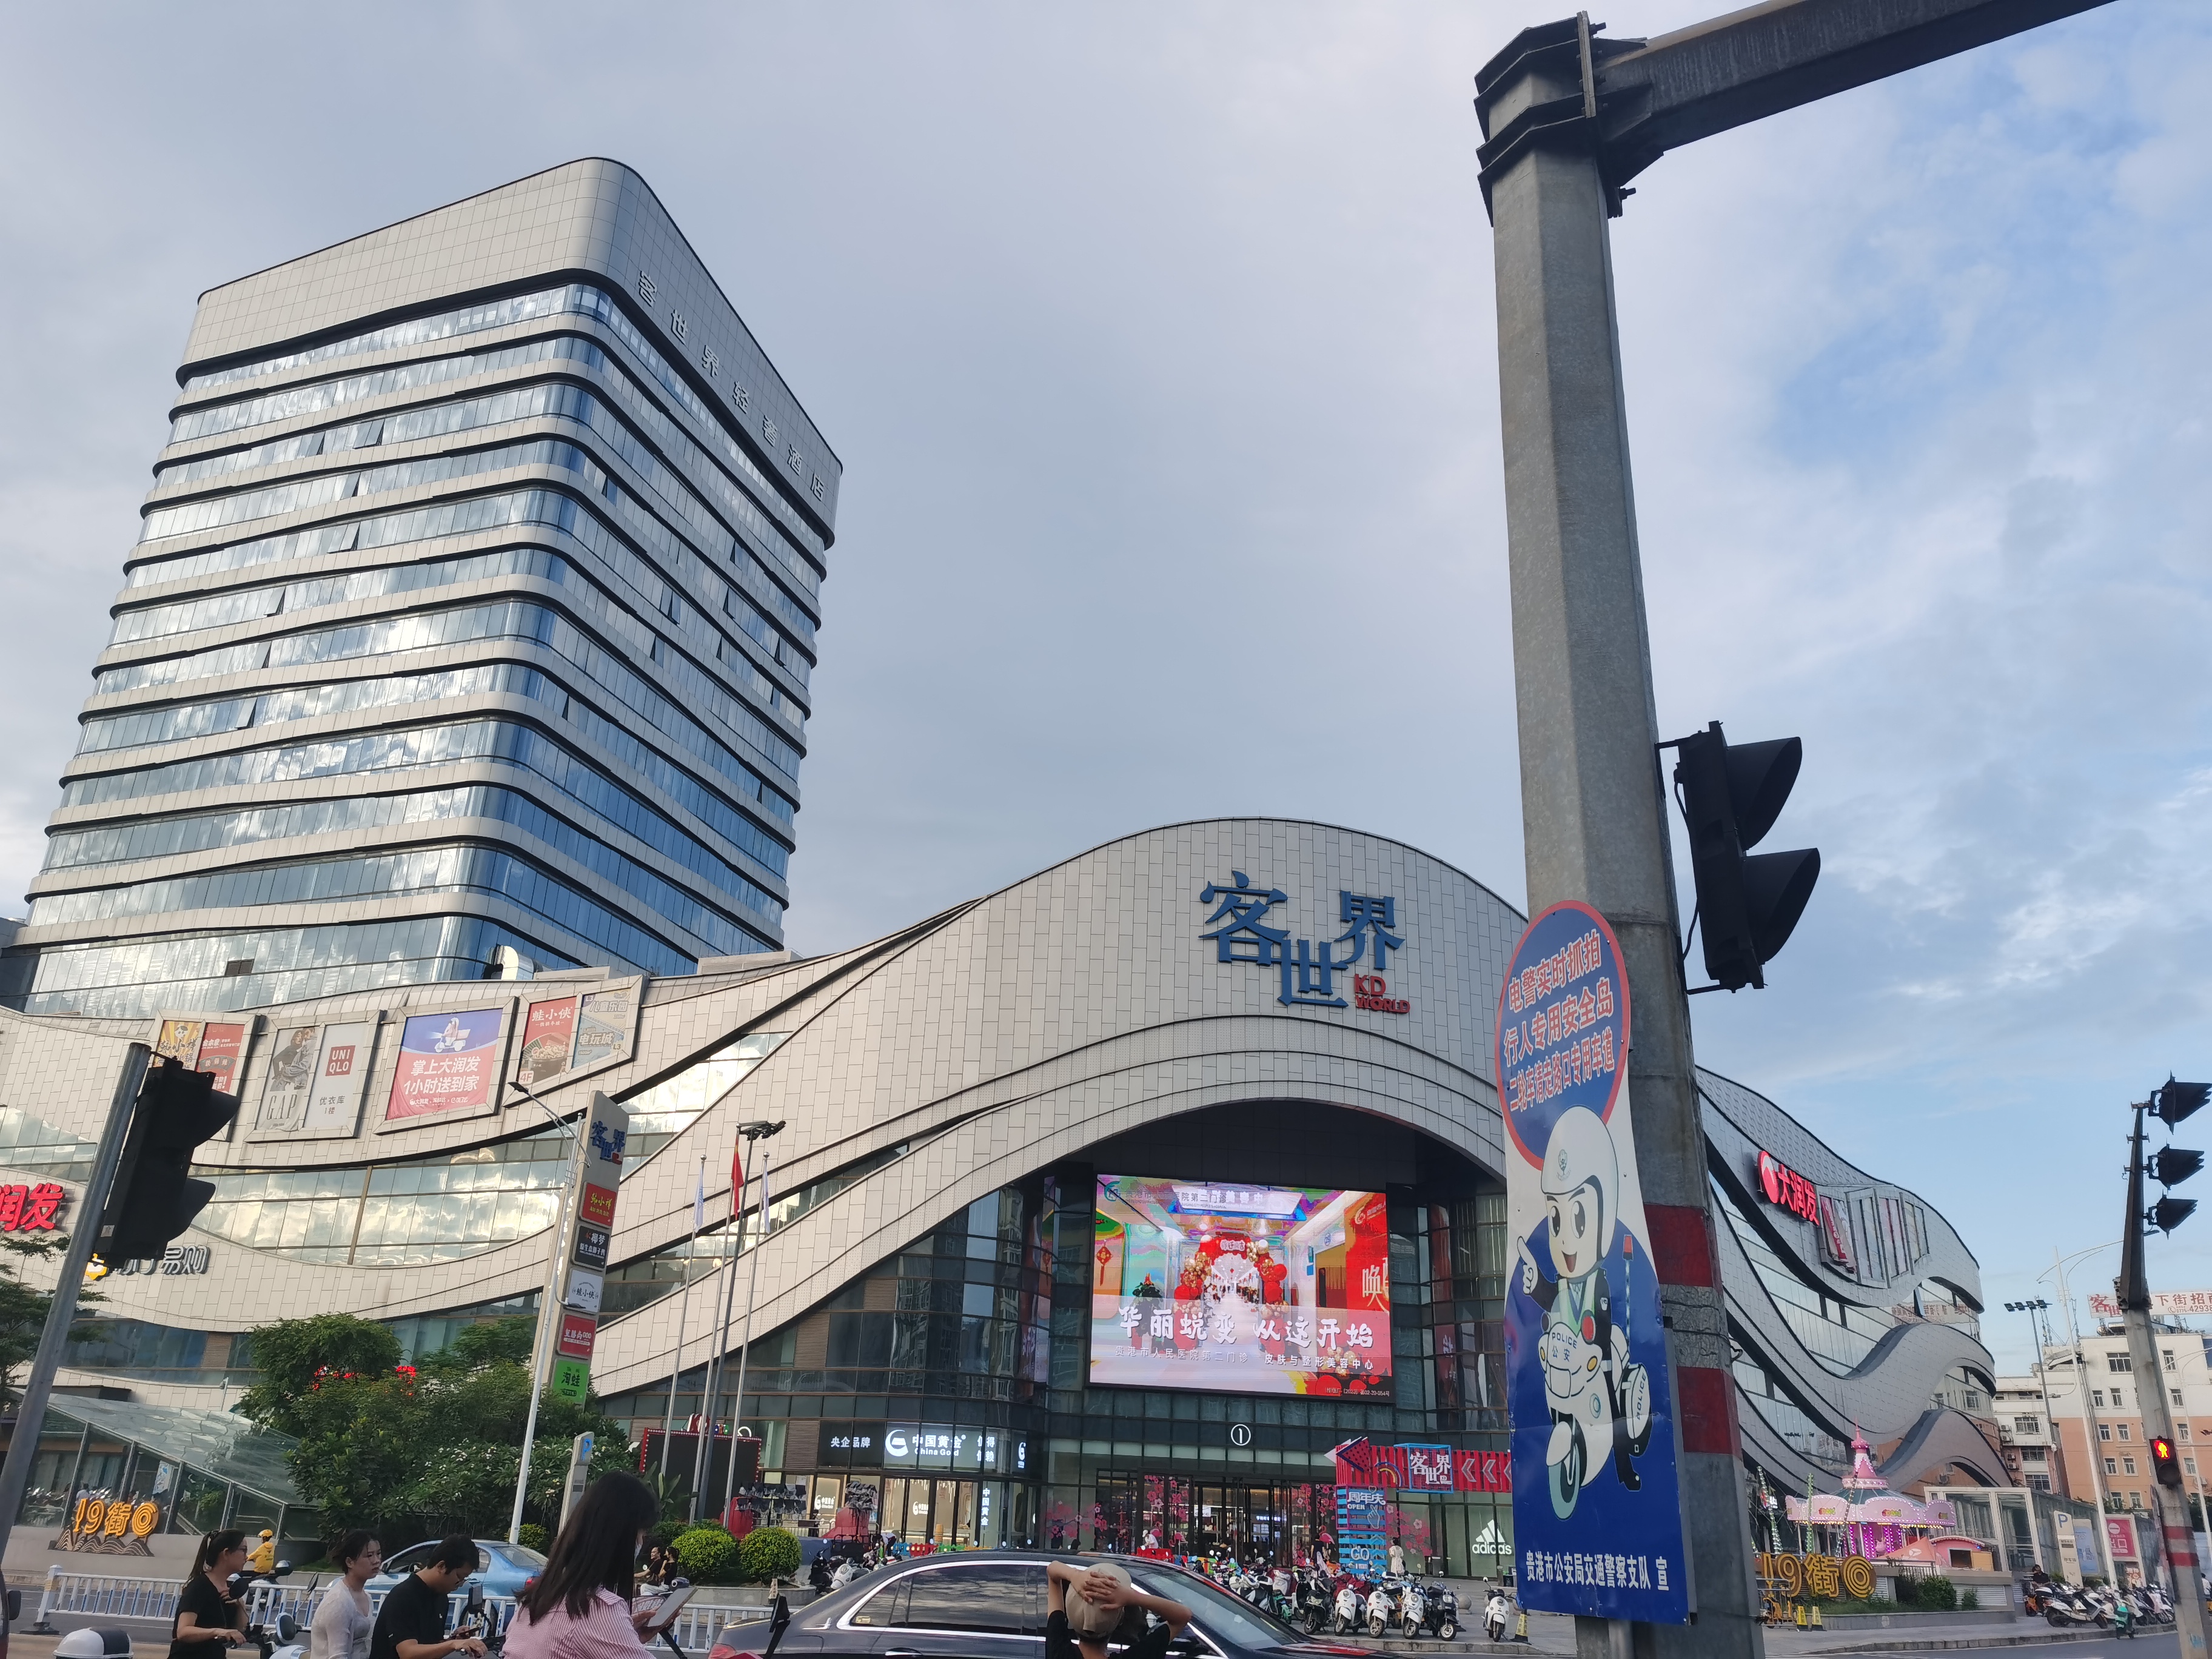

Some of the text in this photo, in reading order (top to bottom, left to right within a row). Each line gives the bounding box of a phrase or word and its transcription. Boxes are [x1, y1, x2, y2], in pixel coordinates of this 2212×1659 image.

[638, 270, 825, 501] 客世界轻奢酒店
[1198, 871, 1406, 1007] 客世界
[1508, 928, 1601, 1013] 电警实时抓拍
[1354, 974, 1387, 996] KD
[532, 1007, 572, 1022] 蛙小侠
[589, 1000, 629, 1013] 儿童乐园
[1356, 995, 1411, 1014] WORLD
[1504, 977, 1614, 1068] 行人专用安全岛
[578, 1032, 615, 1046] 电玩城
[332, 1049, 350, 1061] UNI
[329, 1061, 349, 1074] QLO
[411, 1056, 481, 1076] 掌上大润发
[1509, 1026, 1615, 1112] 二轮车请走路口专用车道
[404, 1074, 480, 1095] 1小时送到家
[520, 1072, 533, 1082] 4F
[267, 1094, 298, 1121] GAP
[319, 1095, 346, 1106] 优衣库
[1777, 1163, 1820, 1226] 大润发
[1119, 1305, 1374, 1351] 华丽蜕变 从这开始
[1552, 1332, 1578, 1350] POLICE
[1114, 1345, 1374, 1370] 贵港市人民医院第二门诊 皮肤与整形美容中心
[1552, 1345, 1570, 1362] 公安
[1637, 1372, 1647, 1421] POLICE
[580, 1438, 592, 1461] P
[830, 1436, 871, 1448] 央企品牌
[912, 1433, 963, 1449] 中国黄金
[939, 1449, 960, 1457] God
[1409, 1452, 1452, 1485] 客世界
[981, 1487, 991, 1526] 中国黄金
[1347, 1491, 1386, 1506] 周年庆
[2057, 1513, 2068, 1529] P
[1350, 1547, 1370, 1561] GO
[1526, 1550, 1669, 1591] 贵港市公安局交通警察支队 宣
